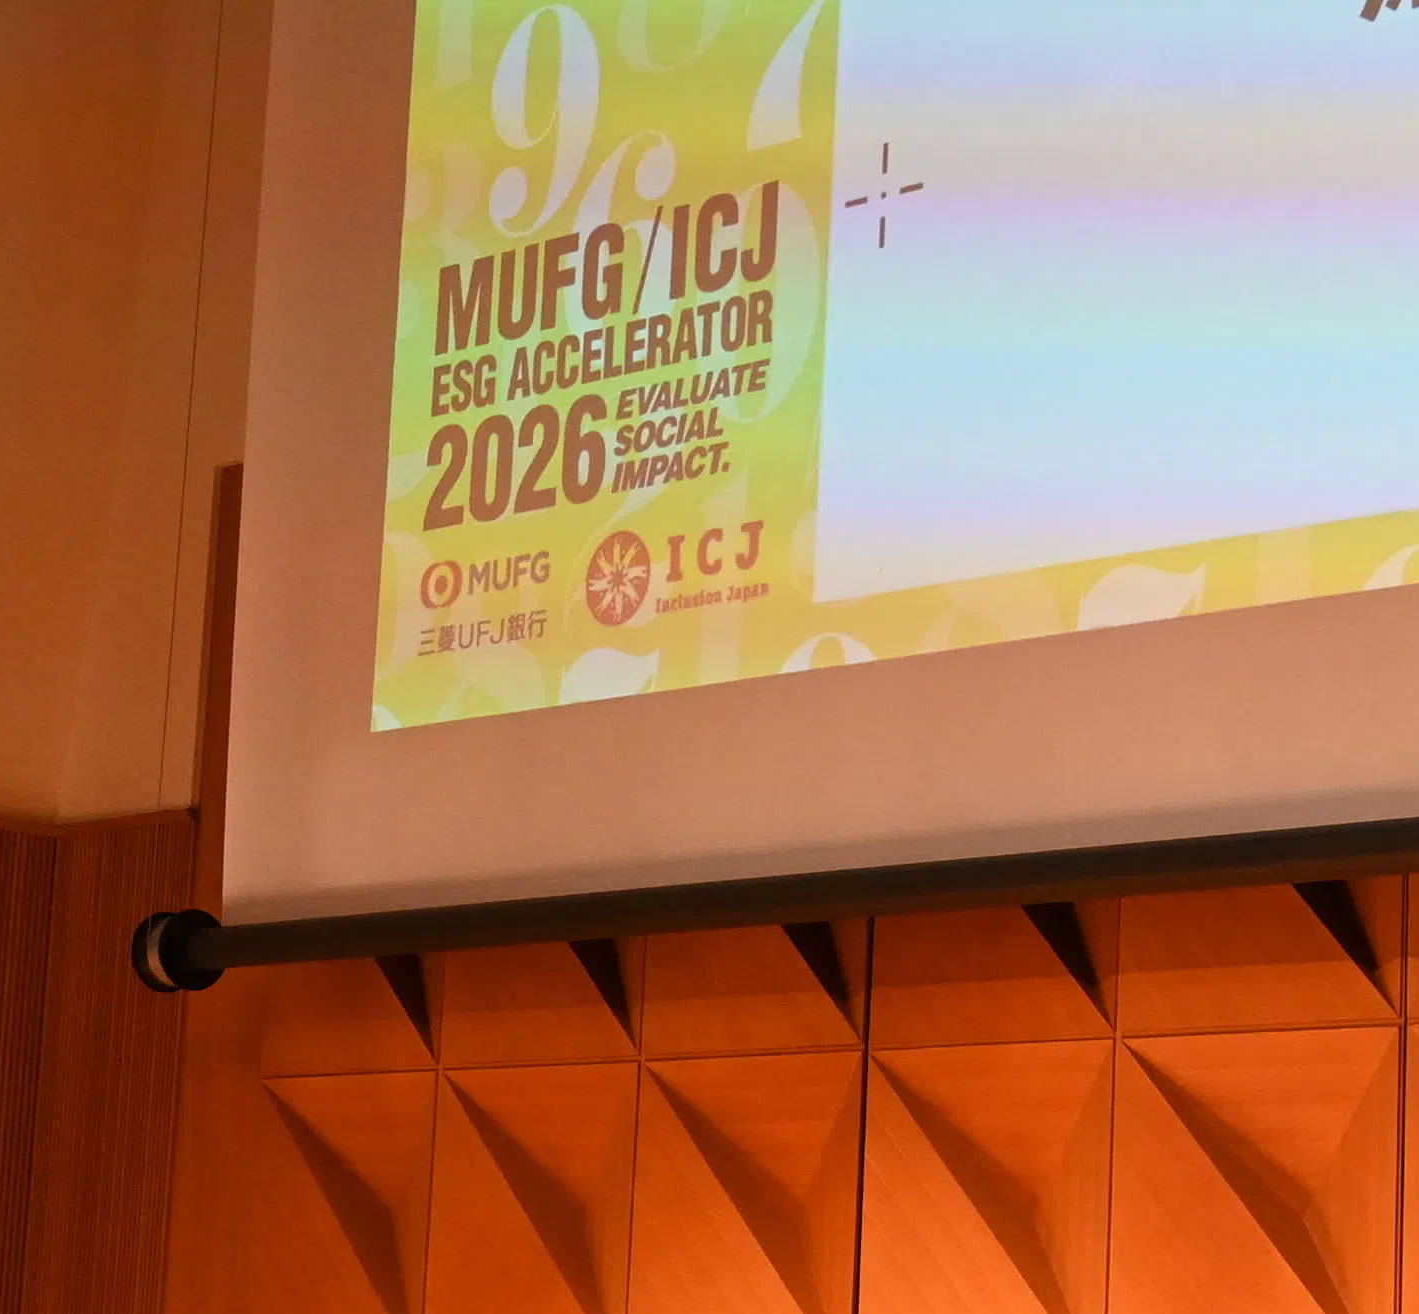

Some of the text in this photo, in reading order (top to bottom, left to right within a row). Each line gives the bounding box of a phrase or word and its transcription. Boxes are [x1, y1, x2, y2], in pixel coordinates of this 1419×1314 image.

[491, 6, 599, 236] 9
[434, 180, 779, 356] MUFG/ICJ
[431, 289, 773, 417] ESG ACCELERATOR
[616, 358, 770, 421] EVALUATE
[422, 394, 607, 531] 2026
[613, 406, 724, 457] SOCIAL
[611, 441, 731, 494] IMPACT.
[467, 551, 551, 595] MUFG
[655, 581, 770, 614] Inclusion Japan
